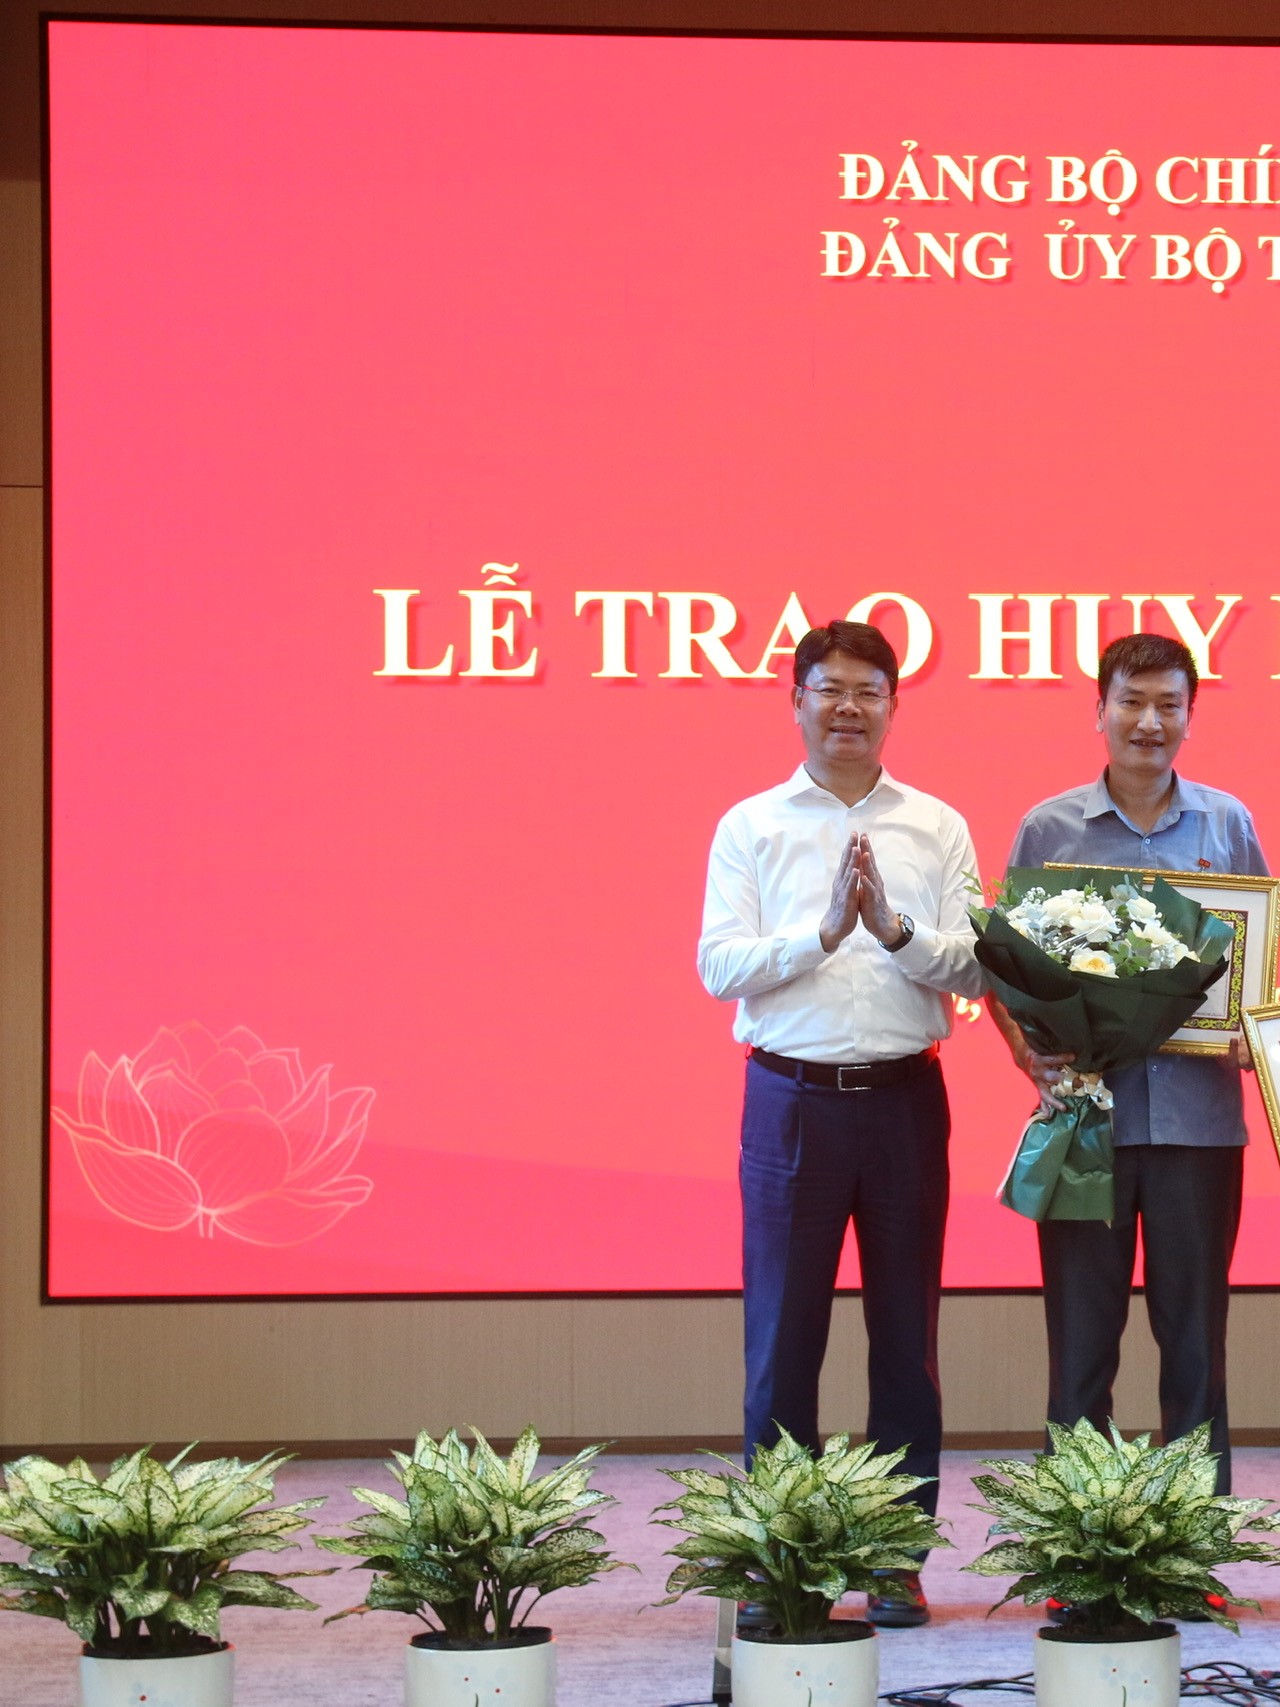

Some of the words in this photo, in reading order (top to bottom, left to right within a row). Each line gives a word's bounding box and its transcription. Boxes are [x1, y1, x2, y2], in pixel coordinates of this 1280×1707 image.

[838, 140, 1030, 203] ĐẢNG
[1045, 149, 1138, 216] BỘ
[820, 217, 1012, 280] ĐẢNG
[1043, 219, 1137, 280] ỦY
[1150, 227, 1242, 294] BỘ
[372, 562, 538, 677] LỄ
[968, 593, 1243, 680] HUY
